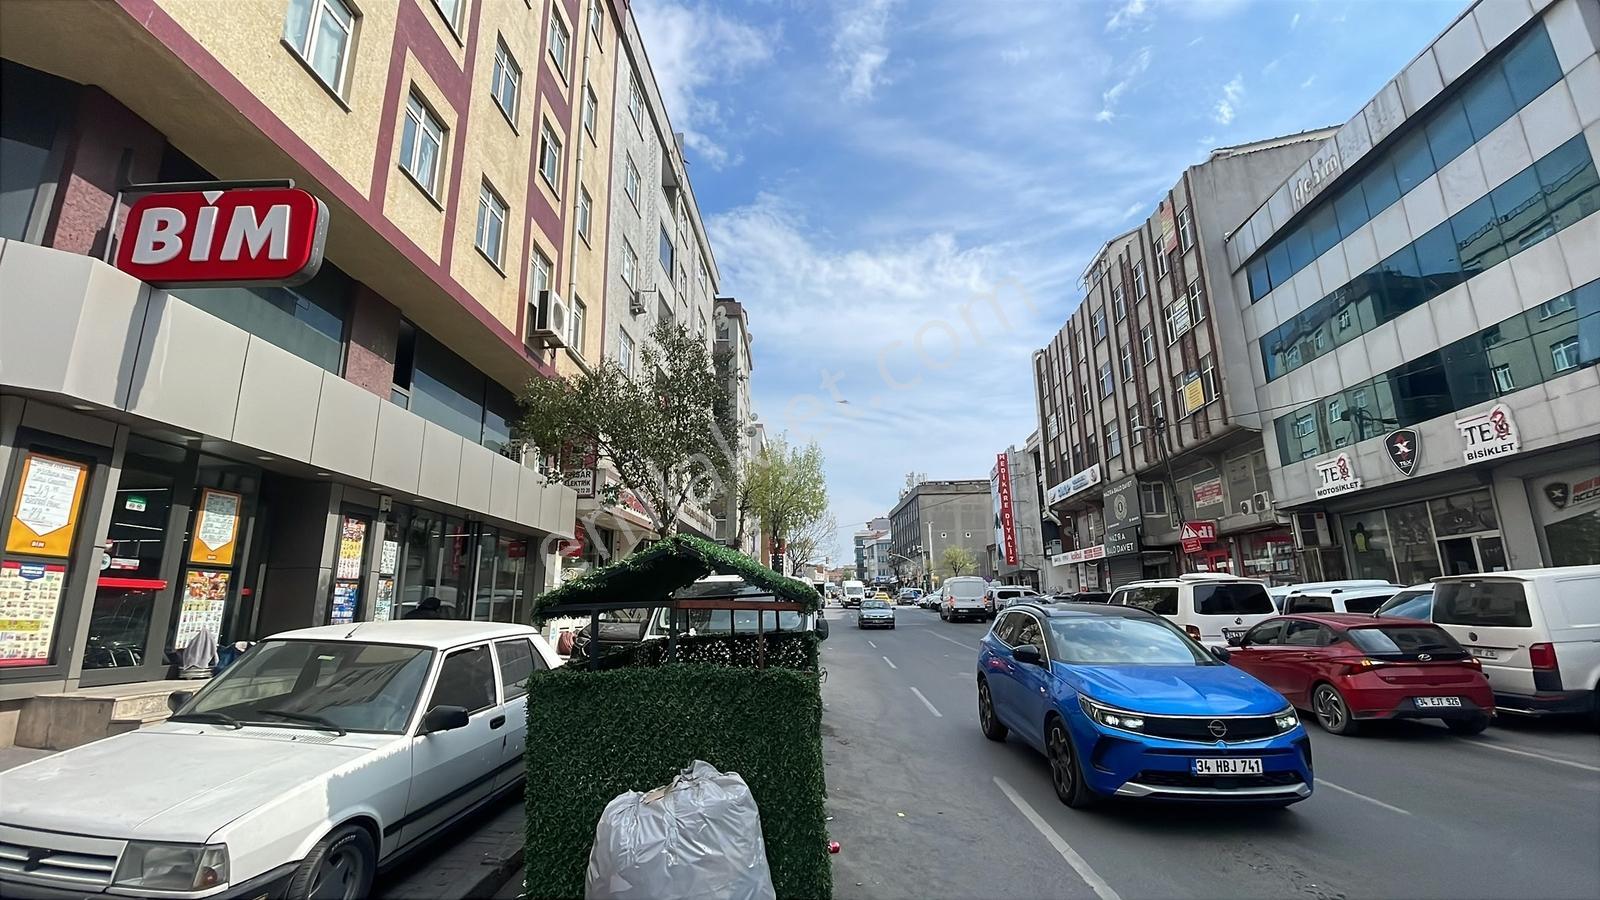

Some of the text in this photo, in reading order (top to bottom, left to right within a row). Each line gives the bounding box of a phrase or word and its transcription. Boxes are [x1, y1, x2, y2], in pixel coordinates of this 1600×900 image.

[131, 190, 291, 265] BİM
[1466, 442, 1515, 461] BİSİKLET
[1317, 481, 1359, 496] MOTOSİKLET
[1197, 760, 1211, 773] 34
[1215, 760, 1237, 773] HBJ
[1241, 760, 1260, 773] 741
